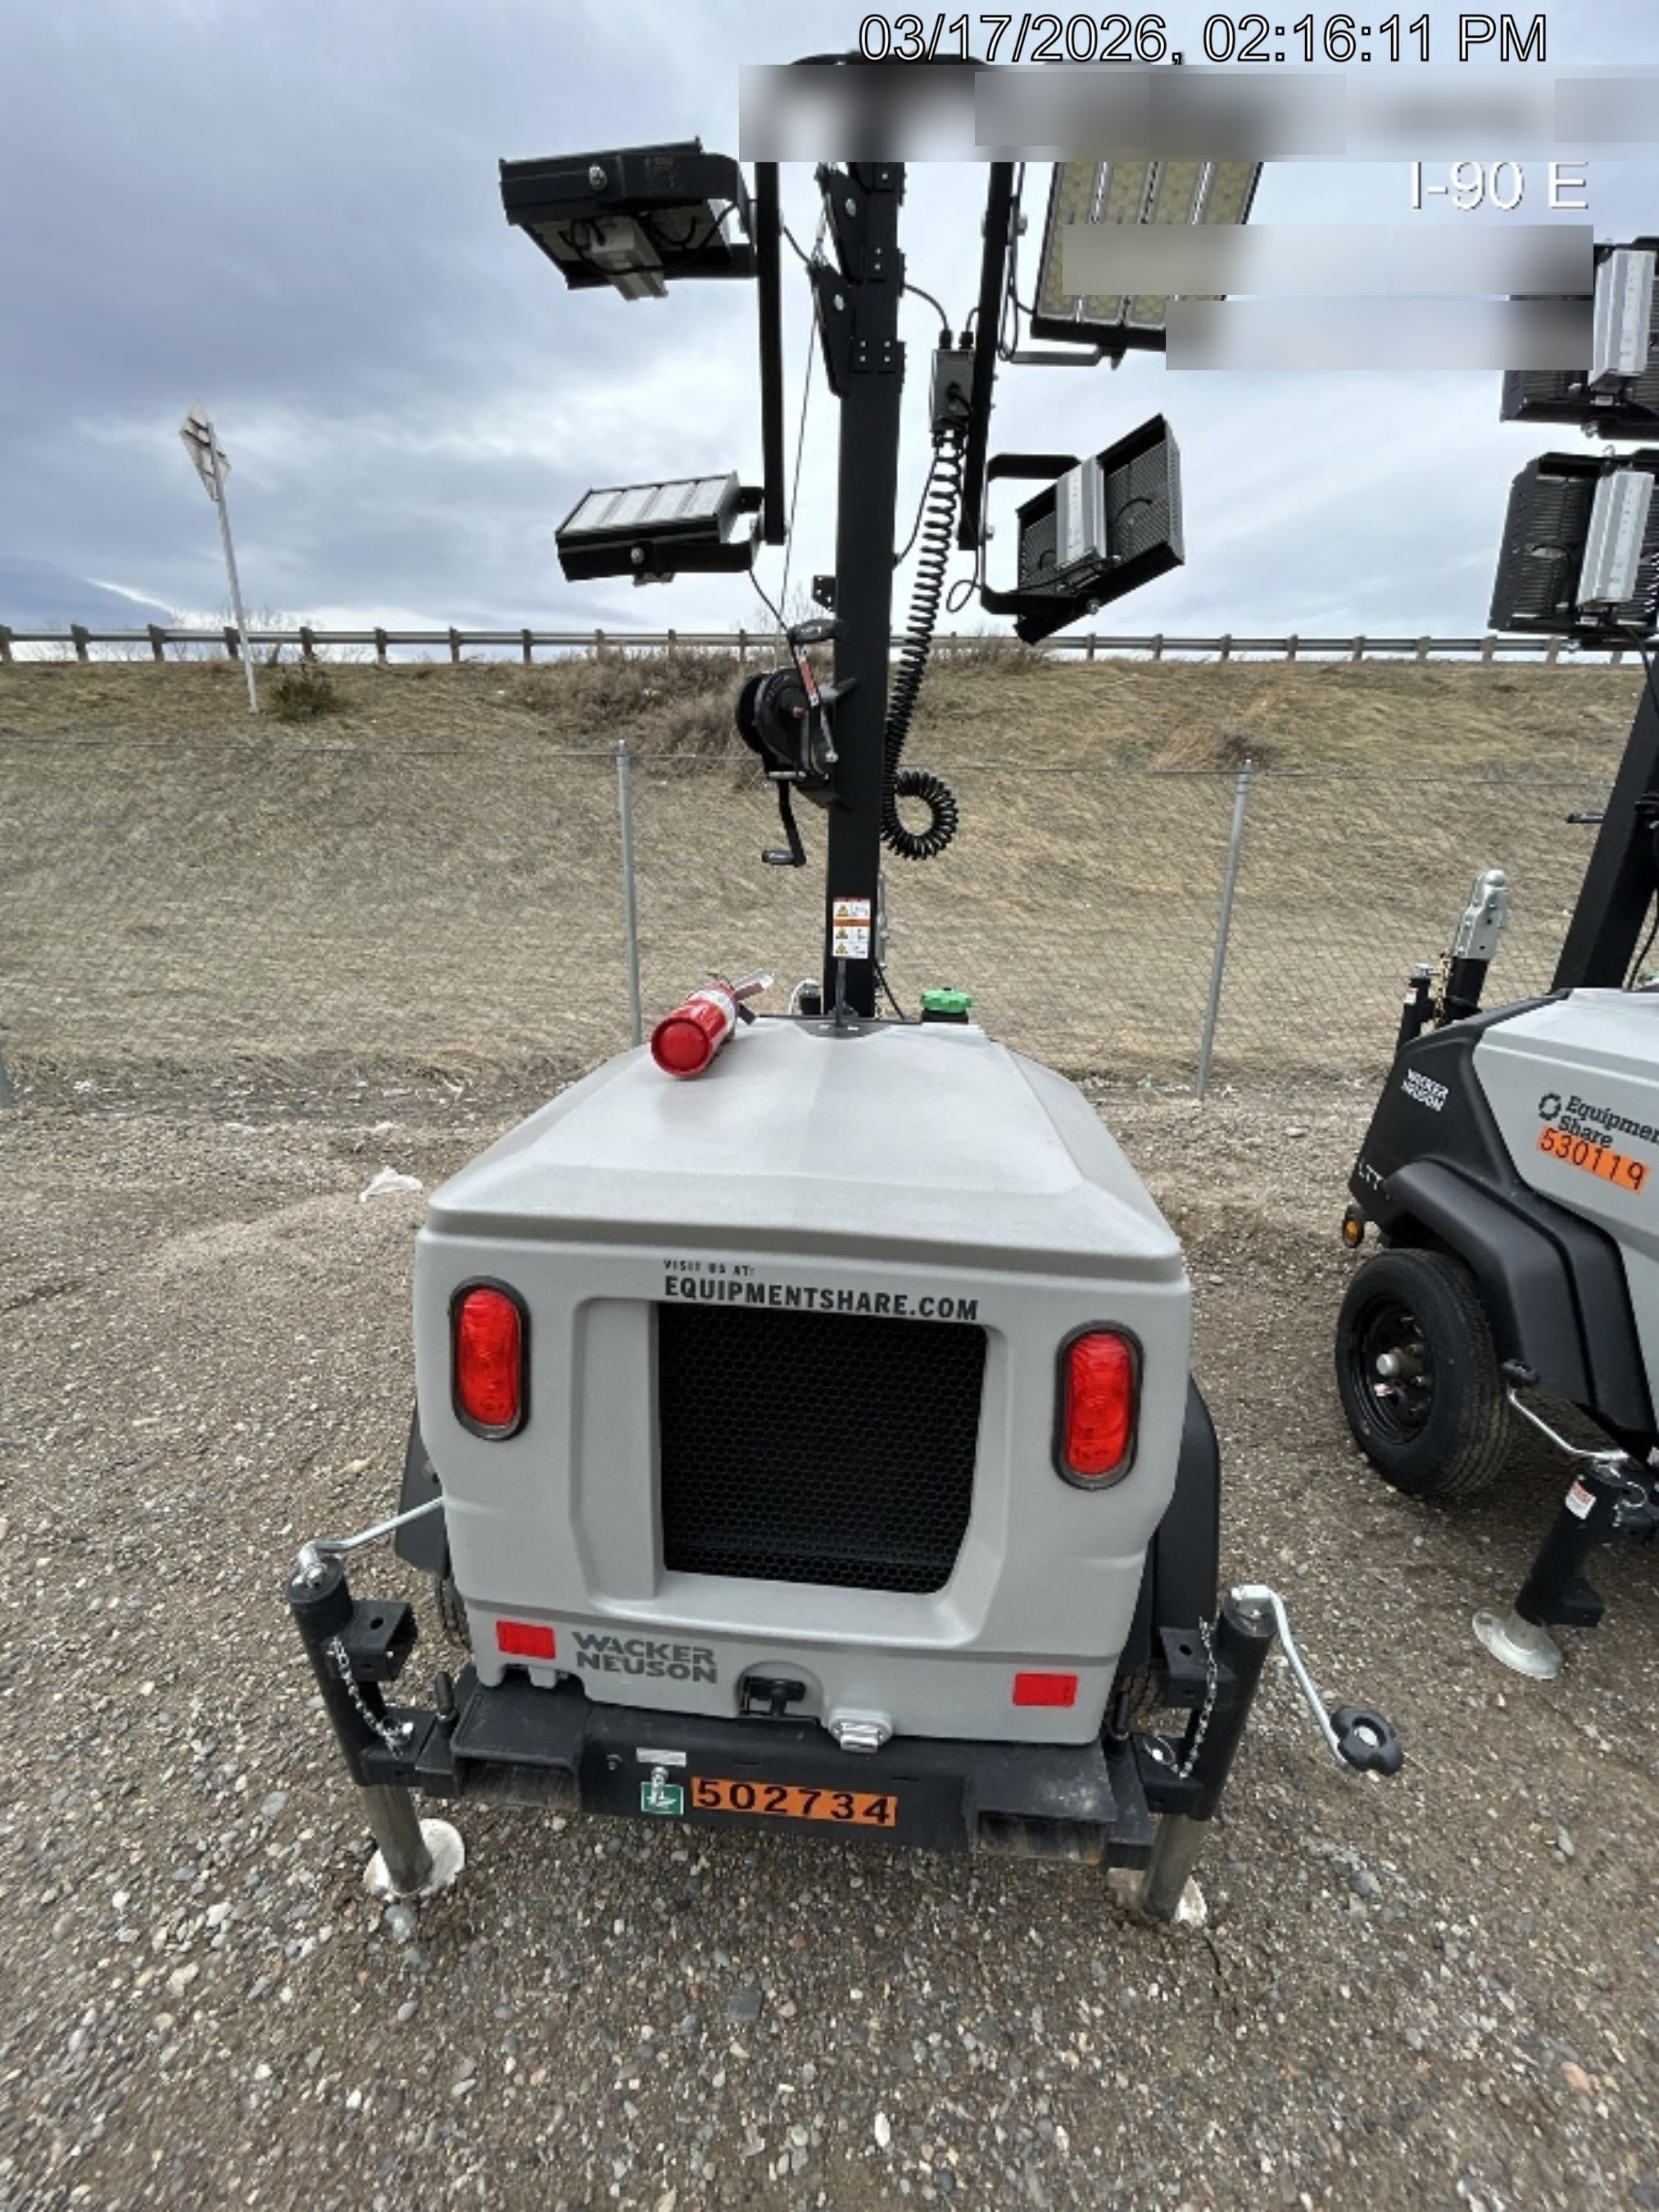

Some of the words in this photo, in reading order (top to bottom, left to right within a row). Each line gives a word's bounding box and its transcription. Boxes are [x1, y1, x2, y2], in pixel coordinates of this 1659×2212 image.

[1558, 1115, 1613, 1148] Share
[1540, 1127, 1645, 1190] 530119
[665, 1275, 979, 1321] EQUIPMENTSHARE.COM
[572, 1631, 718, 1666] WACKER
[577, 1651, 718, 1684] NEUSON
[697, 1779, 890, 1824] 502734
